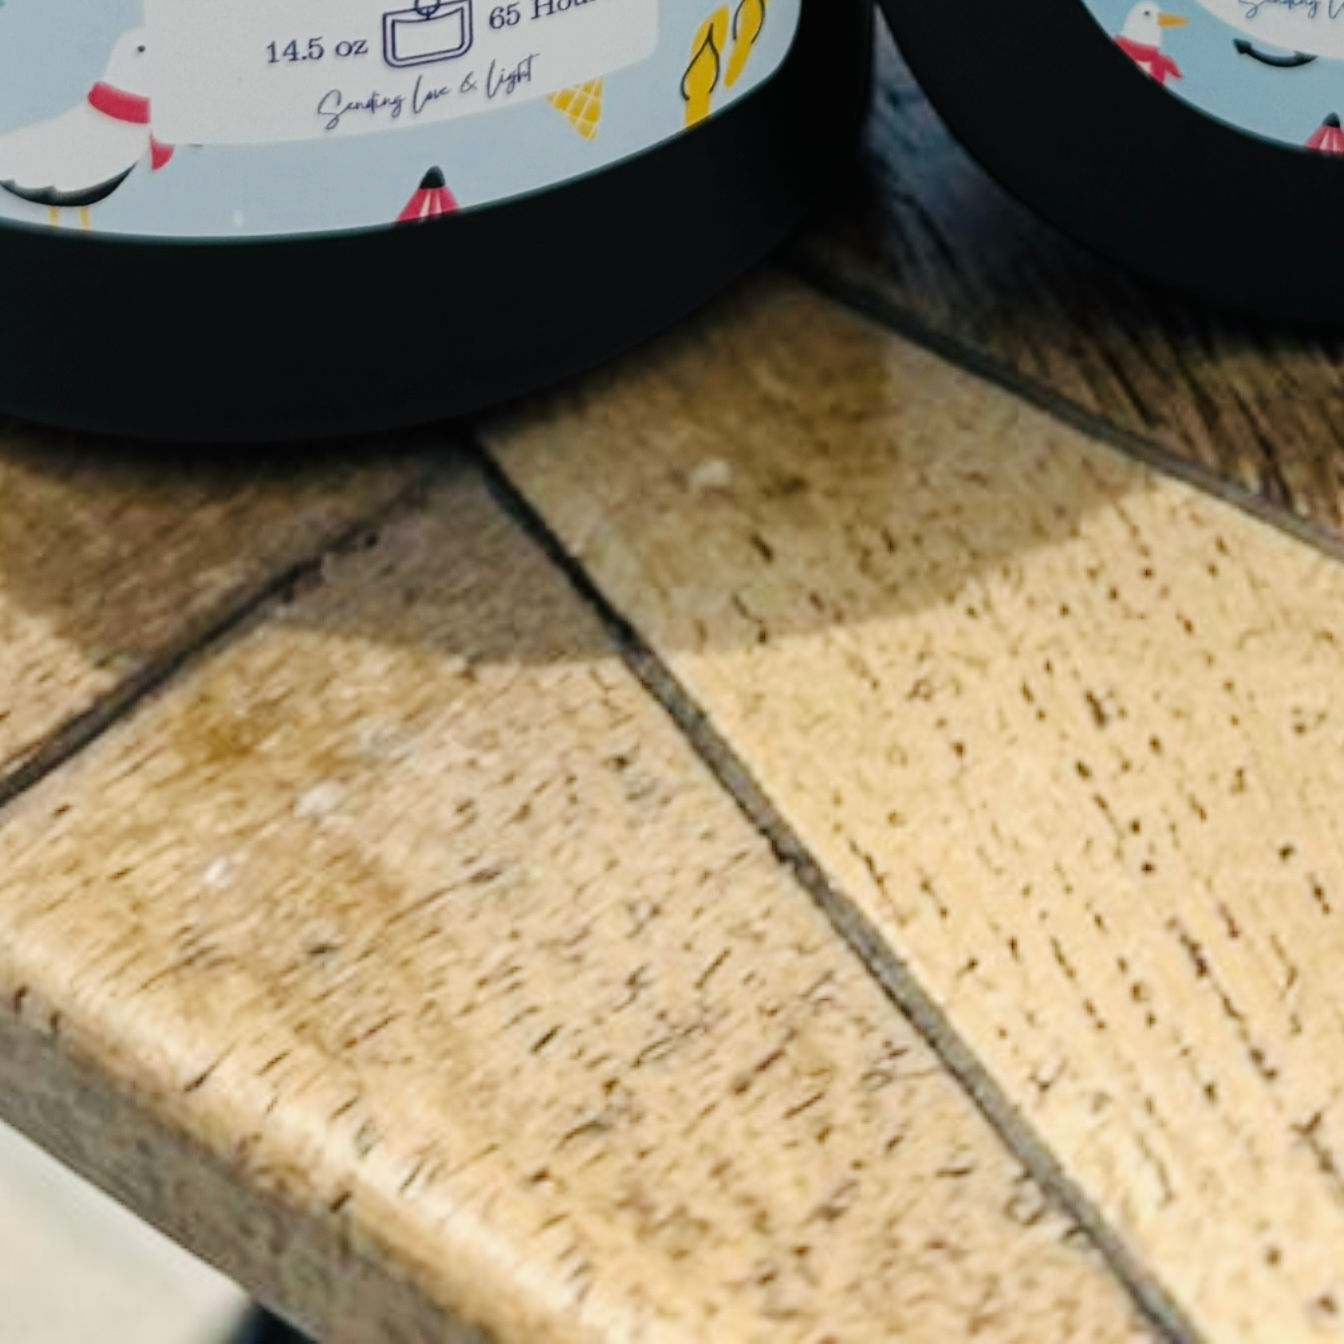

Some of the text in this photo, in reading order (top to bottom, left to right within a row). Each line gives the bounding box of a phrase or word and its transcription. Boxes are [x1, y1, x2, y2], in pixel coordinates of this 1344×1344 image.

[266, 36, 325, 65] 14.5
[334, 39, 369, 58] oz
[488, 1, 522, 31] 65
[317, 54, 538, 131] Sending Love & Light
